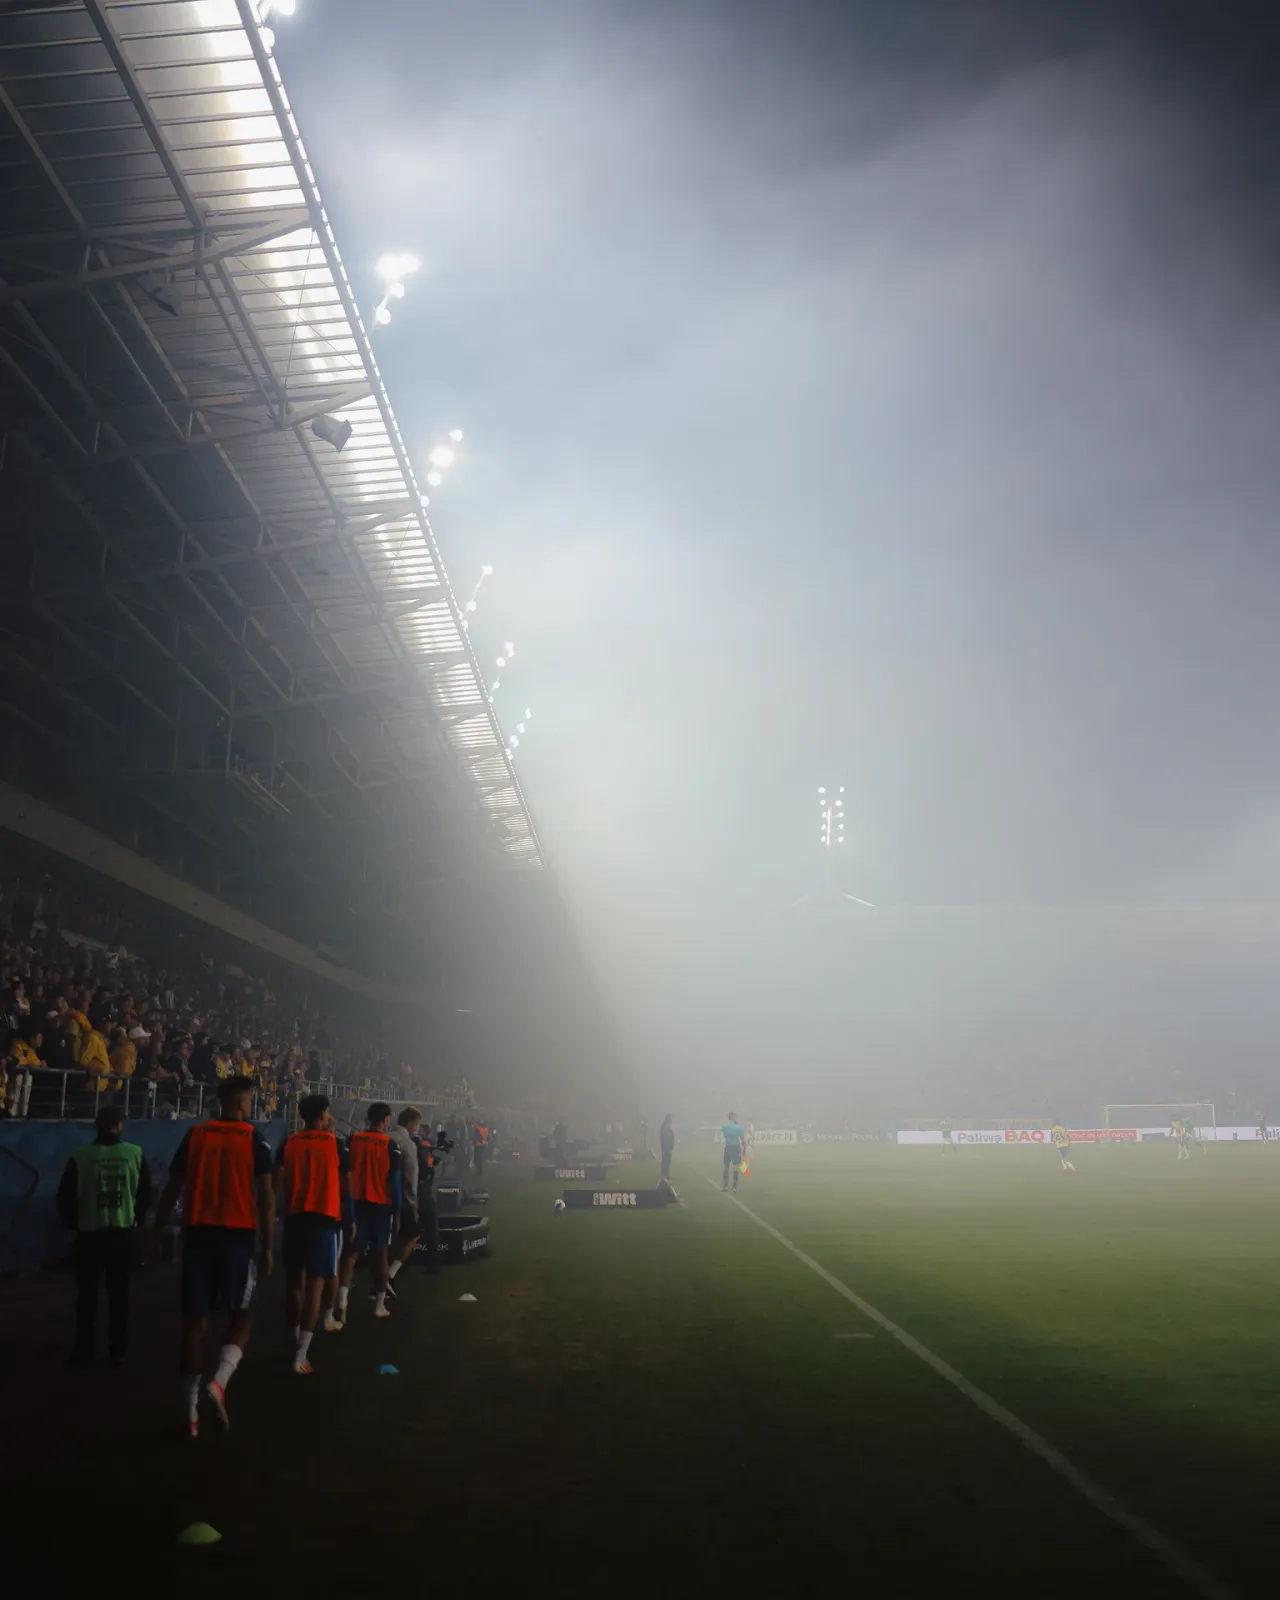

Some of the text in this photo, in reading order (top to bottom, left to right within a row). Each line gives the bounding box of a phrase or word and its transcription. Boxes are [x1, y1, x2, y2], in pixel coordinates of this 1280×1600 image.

[957, 1132, 1001, 1142] Paliwa
[1004, 1130, 1044, 1142] BAQ
[599, 1192, 637, 1206] Witt
